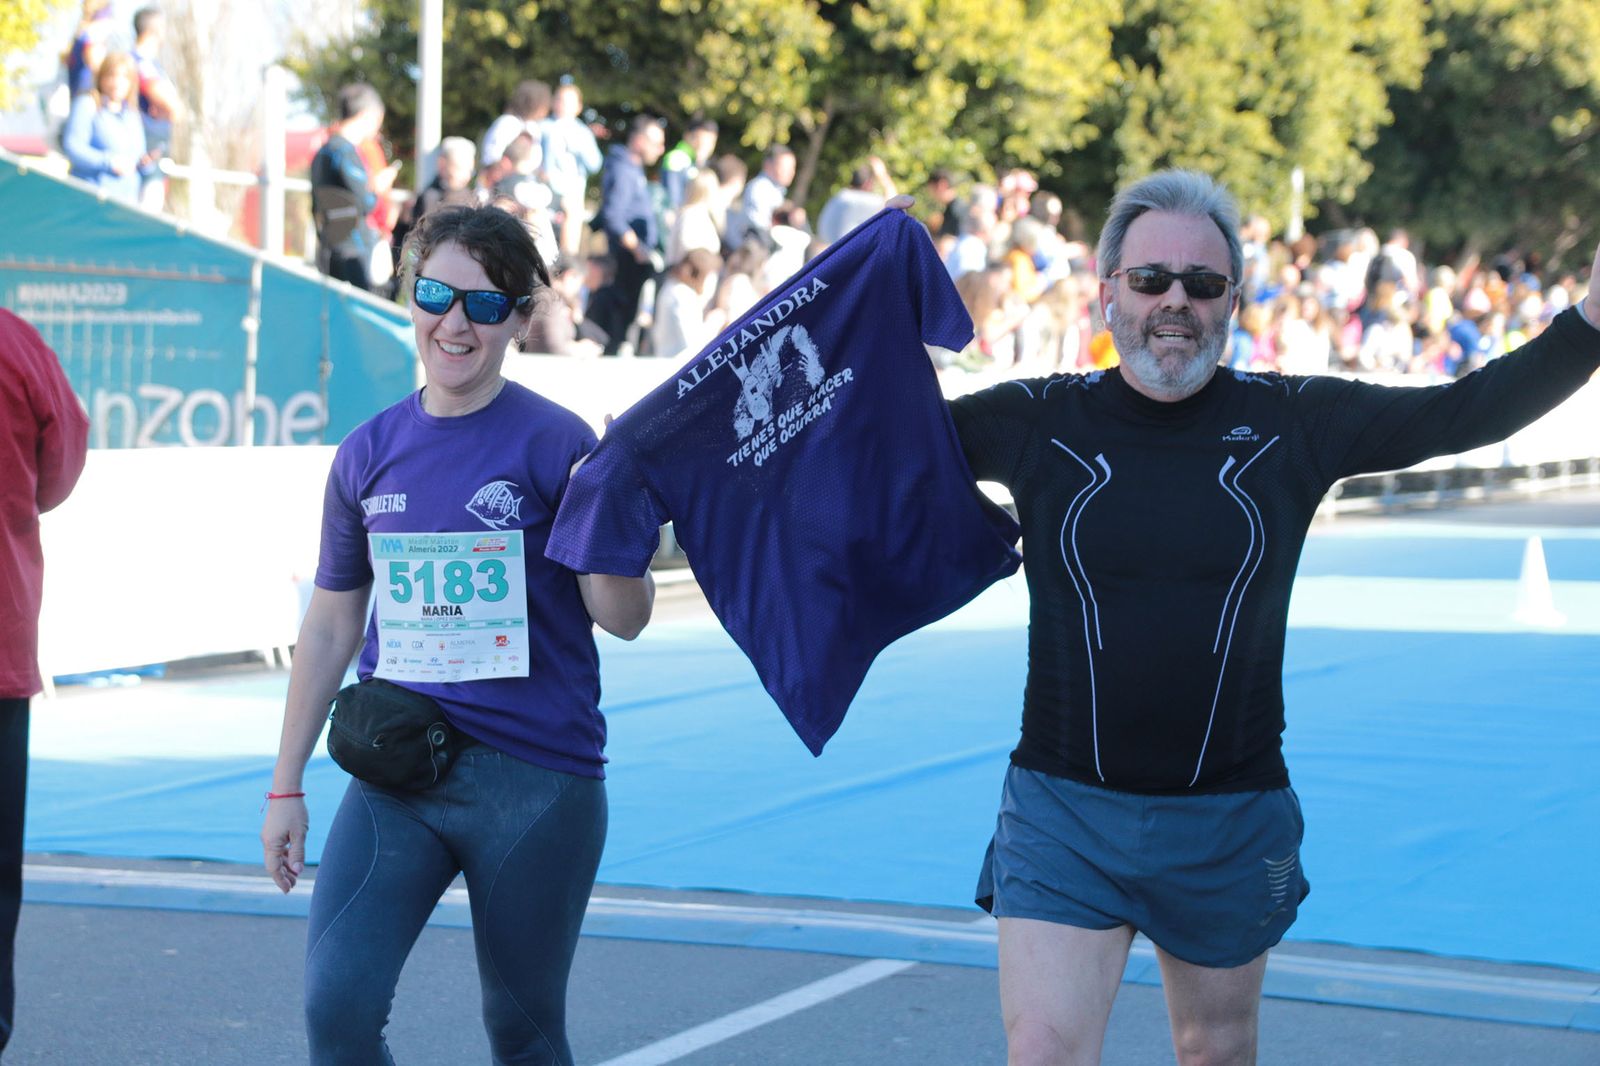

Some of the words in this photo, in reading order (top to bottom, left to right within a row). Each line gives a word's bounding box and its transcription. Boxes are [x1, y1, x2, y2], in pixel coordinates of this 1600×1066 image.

[677, 277, 829, 400] ALEJANDRA
[80, 384, 328, 449] nzone
[777, 402, 804, 428] QUE
[808, 368, 854, 407] HACER
[754, 437, 778, 467] QUE
[389, 559, 509, 605] 5183
[422, 605, 463, 616] MARIA
